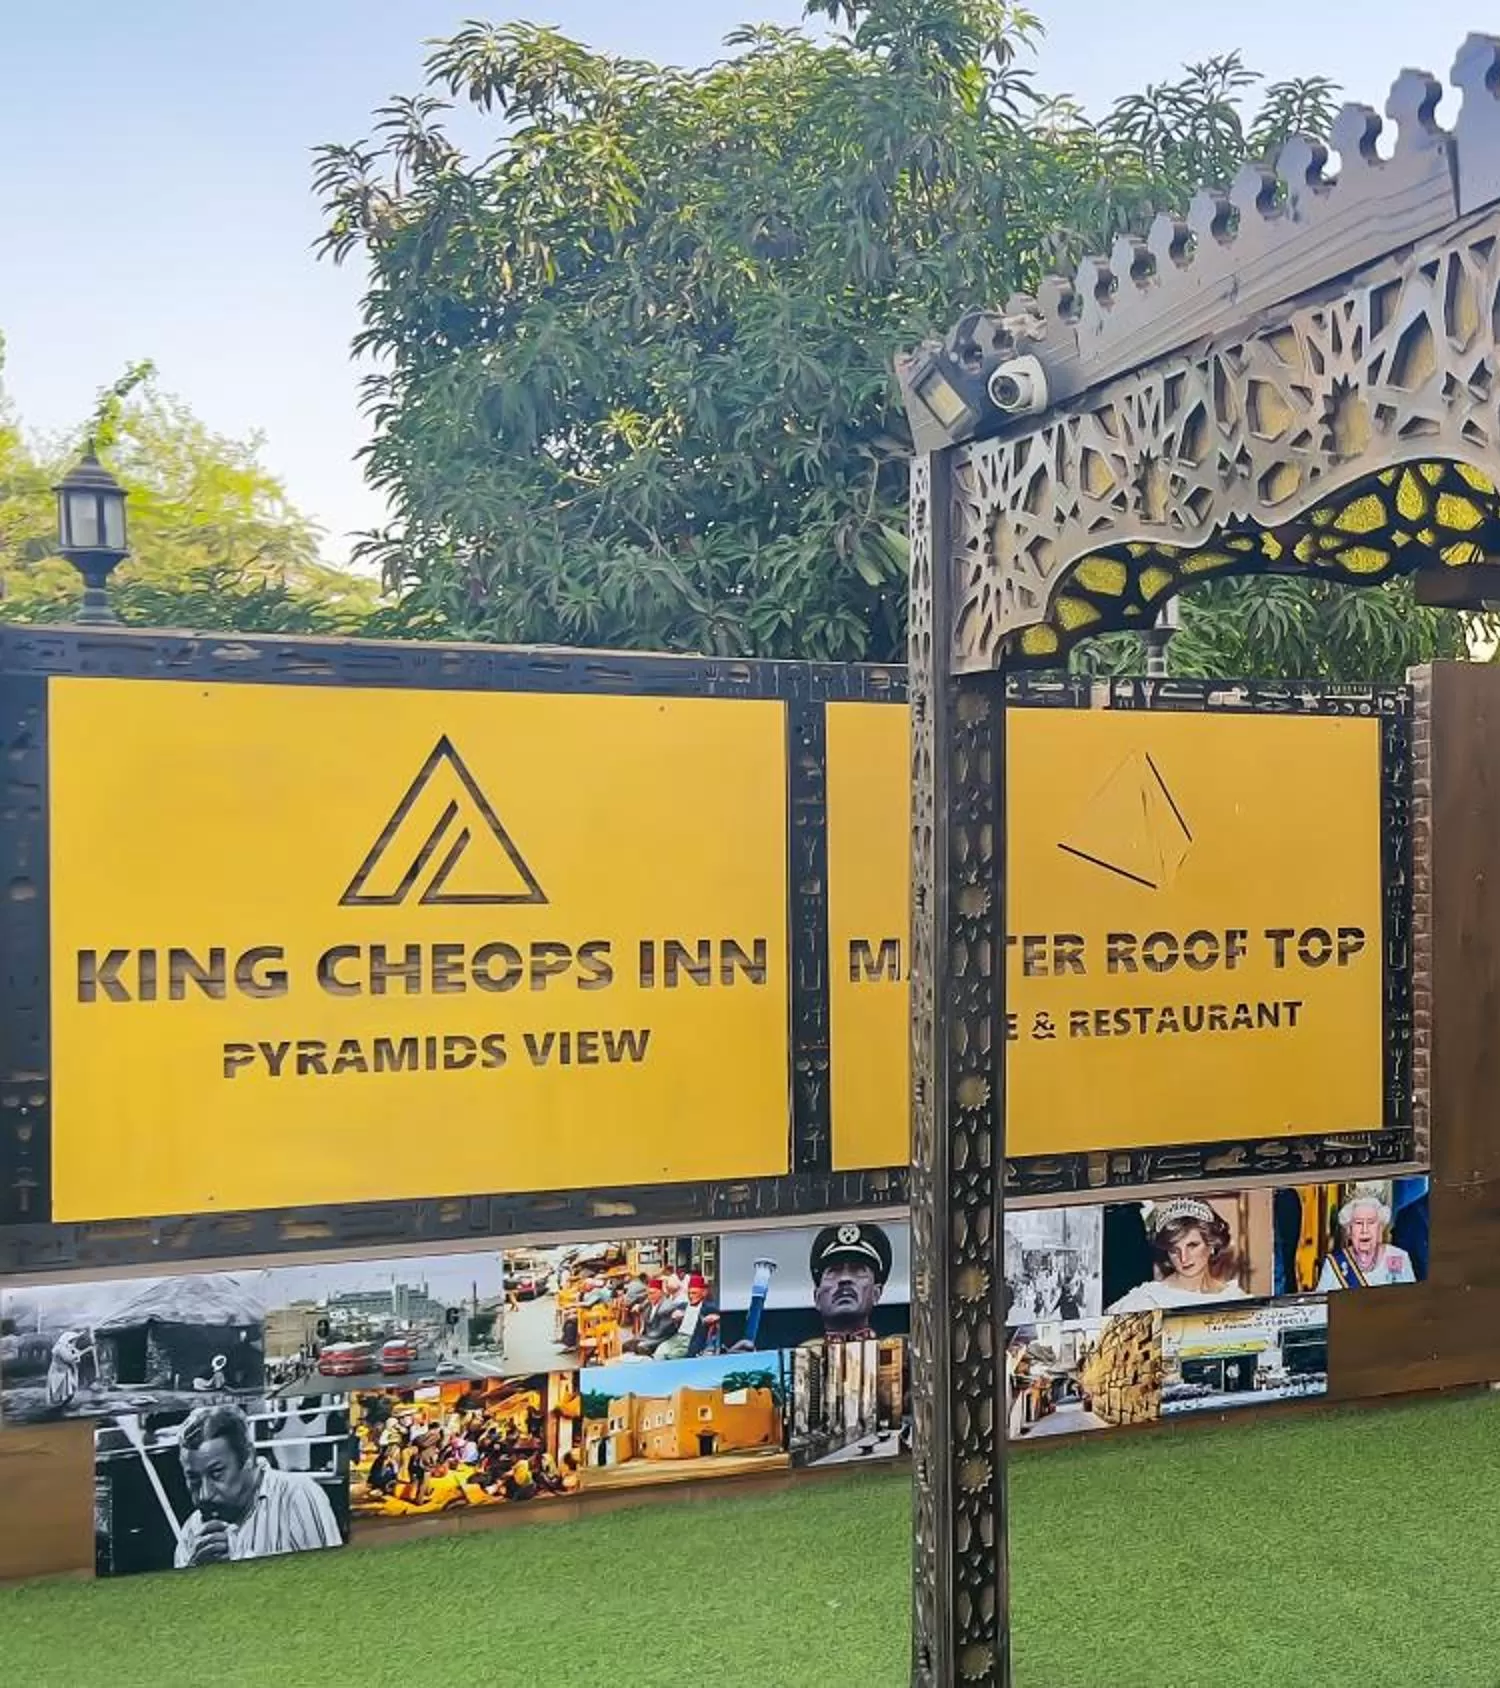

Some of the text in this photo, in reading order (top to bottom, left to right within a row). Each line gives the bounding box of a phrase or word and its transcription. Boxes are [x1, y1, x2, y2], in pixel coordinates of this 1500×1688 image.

[76, 938, 768, 1003] KING CHEOPS INN
[1107, 929, 1248, 974] ROOF
[1264, 926, 1365, 969] TOP
[1031, 1011, 1056, 1039] &
[1069, 1001, 1303, 1039] RESTAURANT
[223, 1028, 651, 1079] PYRAMIDS VIEW
